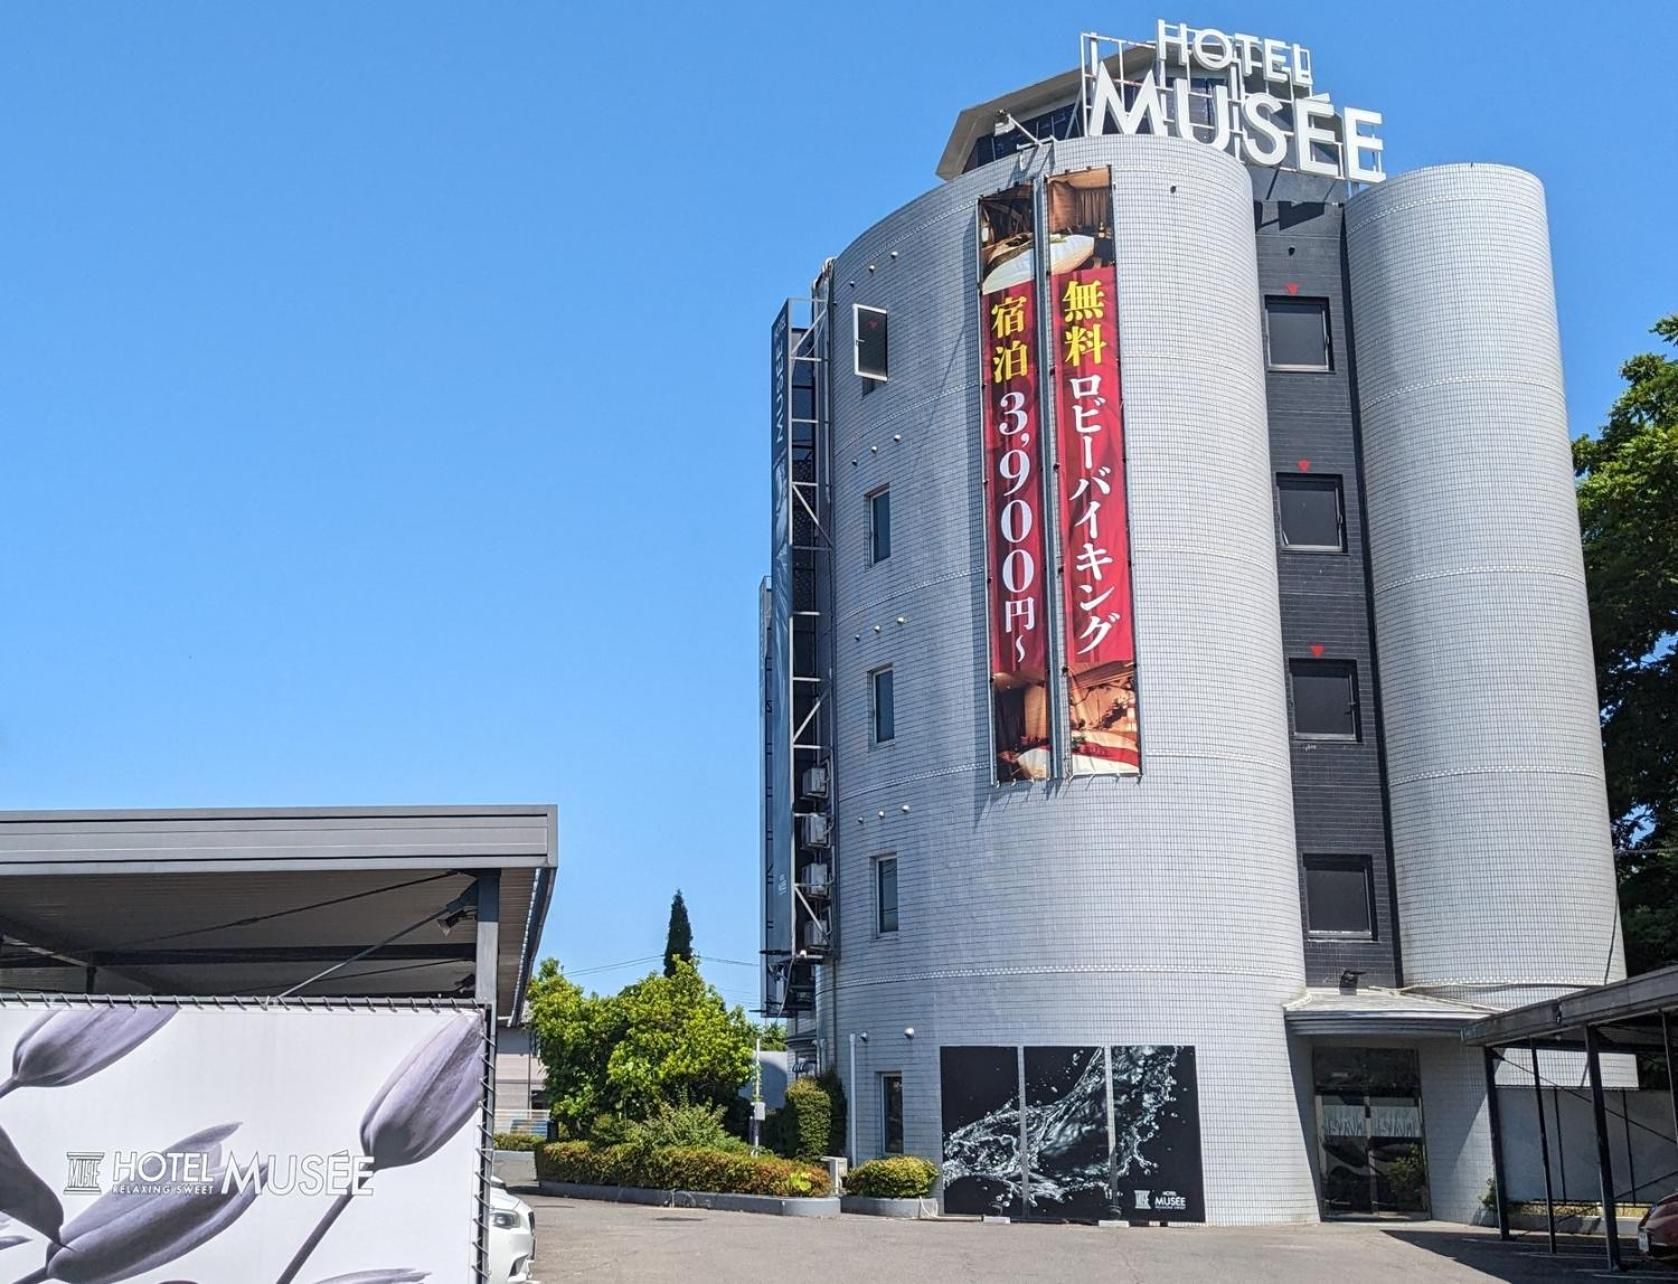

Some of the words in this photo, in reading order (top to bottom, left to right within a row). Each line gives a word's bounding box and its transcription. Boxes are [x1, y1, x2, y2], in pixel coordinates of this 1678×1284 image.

[1157, 19, 1313, 87] HOTEL
[1088, 60, 1387, 184] MUSÉE
[112, 1151, 215, 1183] HOTEL
[220, 1150, 375, 1197] MUSÉE
[112, 1184, 171, 1195] RELAXING
[176, 1184, 215, 1195] SWEET
